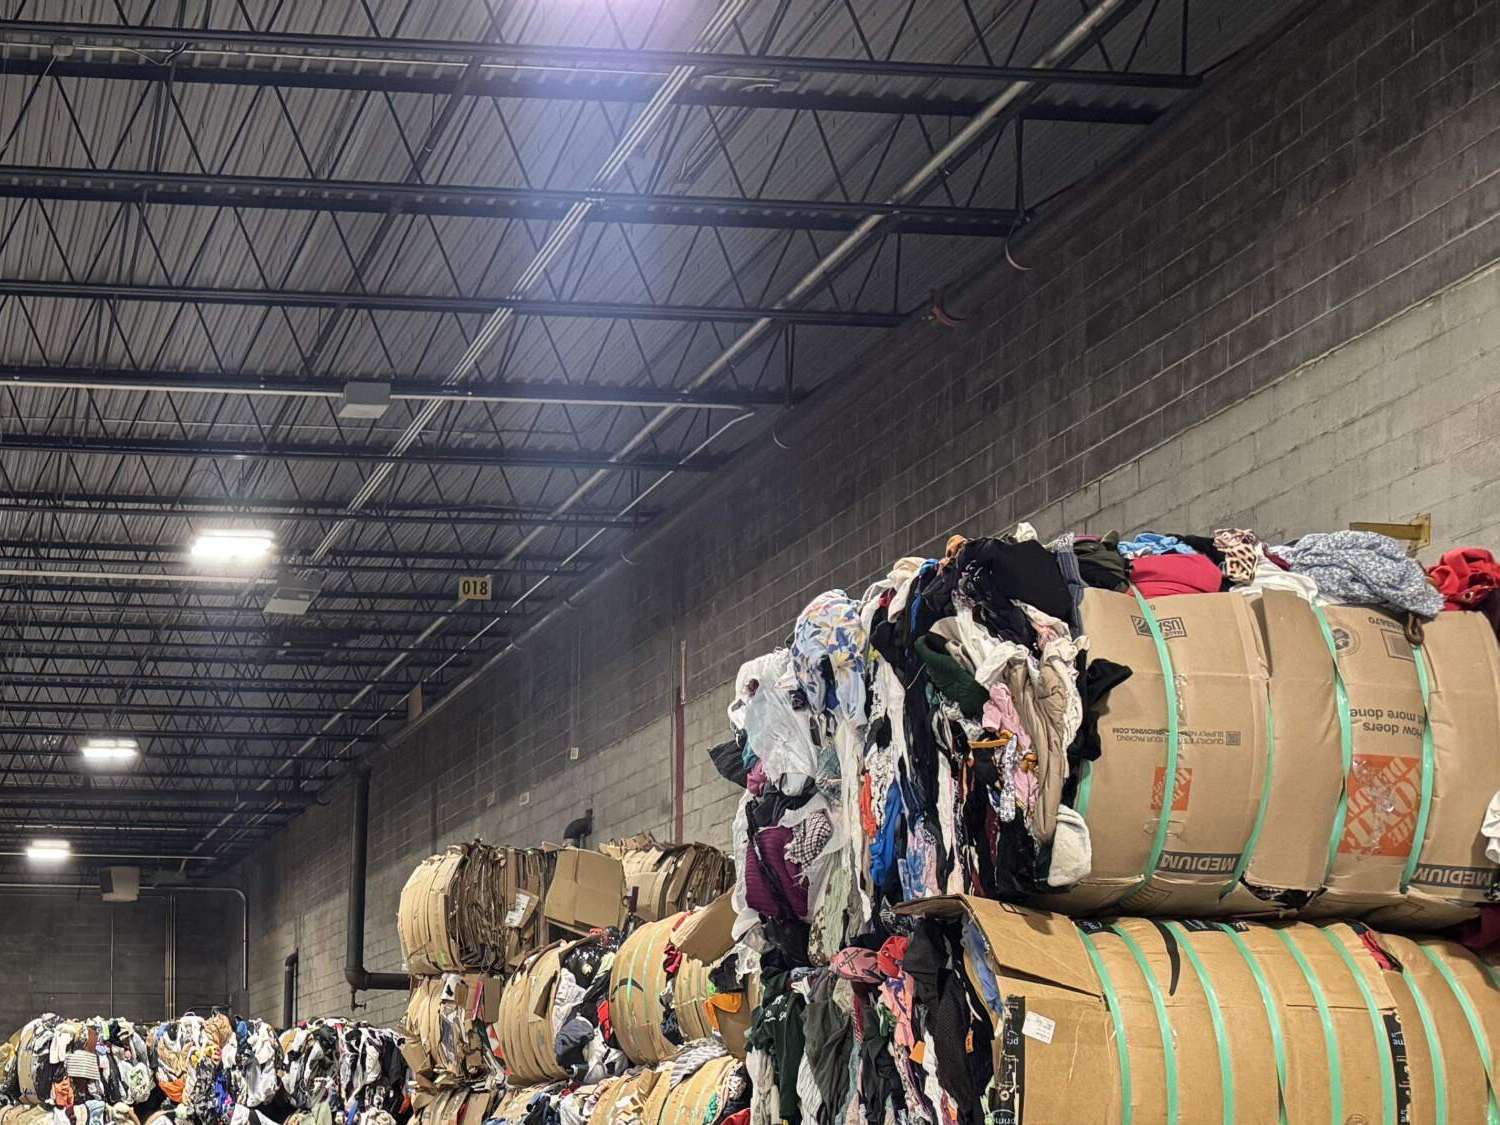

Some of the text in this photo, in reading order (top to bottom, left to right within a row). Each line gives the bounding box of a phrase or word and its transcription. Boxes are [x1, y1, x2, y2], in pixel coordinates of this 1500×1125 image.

[461, 580, 489, 597] 018
[1350, 708, 1415, 721] done more
[1362, 722, 1400, 736] doers
[1160, 854, 1236, 871] MEDIUM
[1412, 867, 1493, 886] MEDIUM
